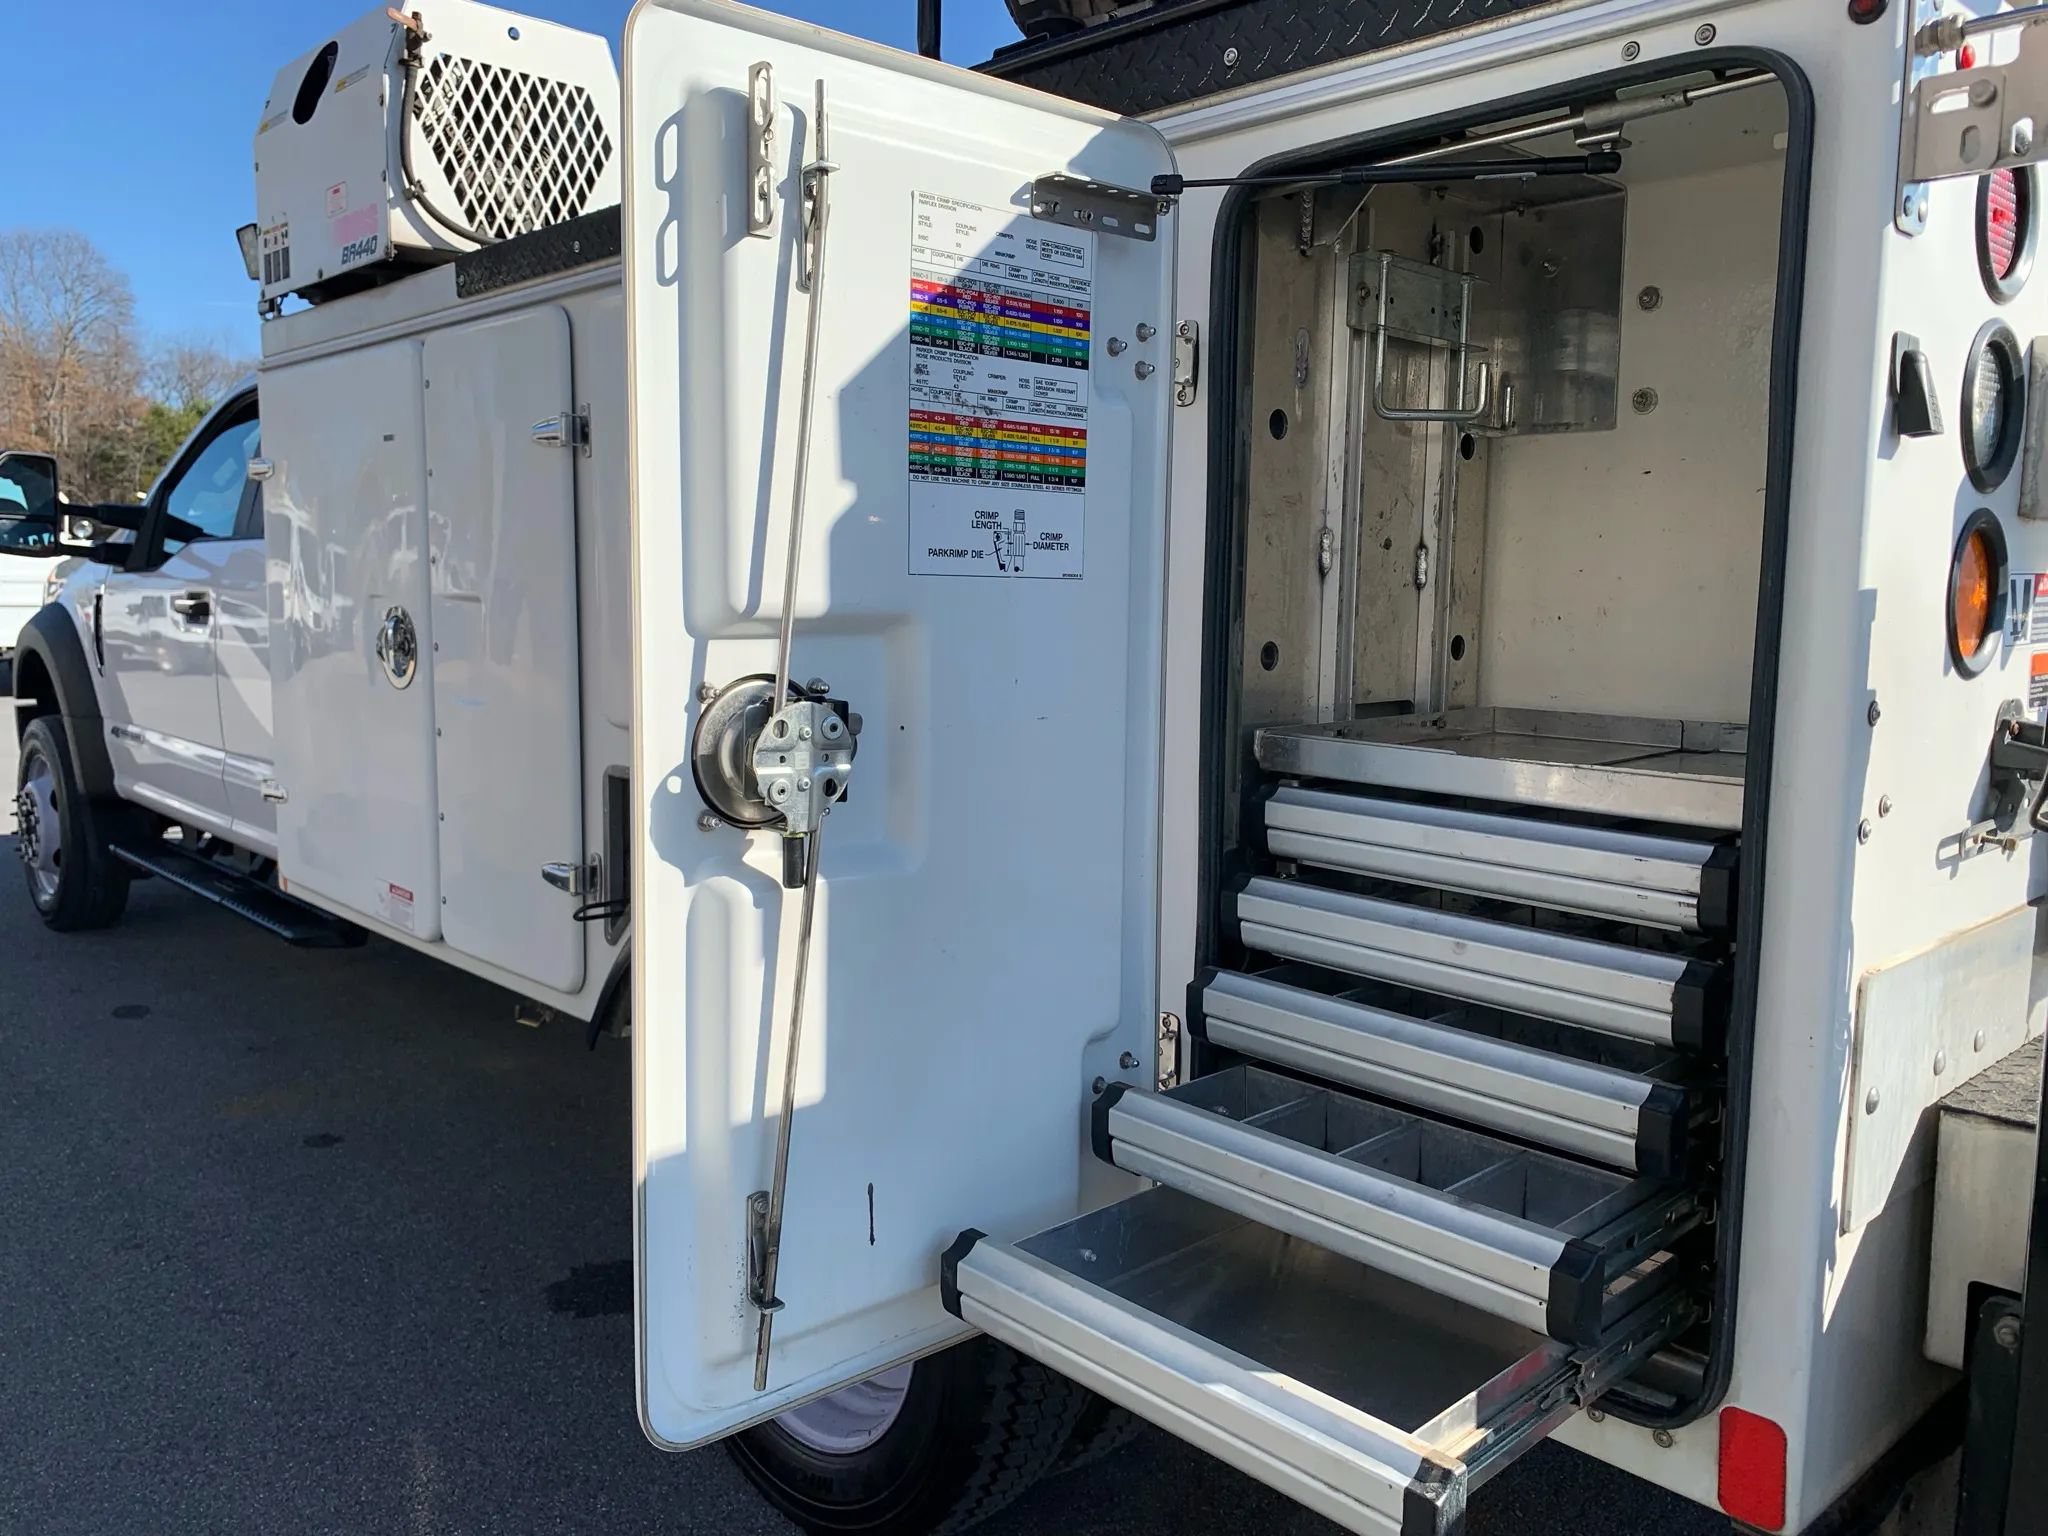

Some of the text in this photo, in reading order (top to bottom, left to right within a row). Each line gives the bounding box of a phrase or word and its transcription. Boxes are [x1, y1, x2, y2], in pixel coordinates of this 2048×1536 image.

[938, 203, 956, 211] DIVISION
[952, 200, 982, 211] SPECIFICATION
[956, 223, 976, 231] COUPLING
[1042, 242, 1071, 252] NON-CONDUCTIVE
[949, 352, 979, 360] SPECIFICATION
[975, 511, 999, 519] CRIMP
[972, 521, 1001, 530] LENGTH
[1040, 532, 1062, 540] CRIMP
[1033, 542, 1069, 551] DIAMETER
[928, 548, 968, 557] PARKRIMP
